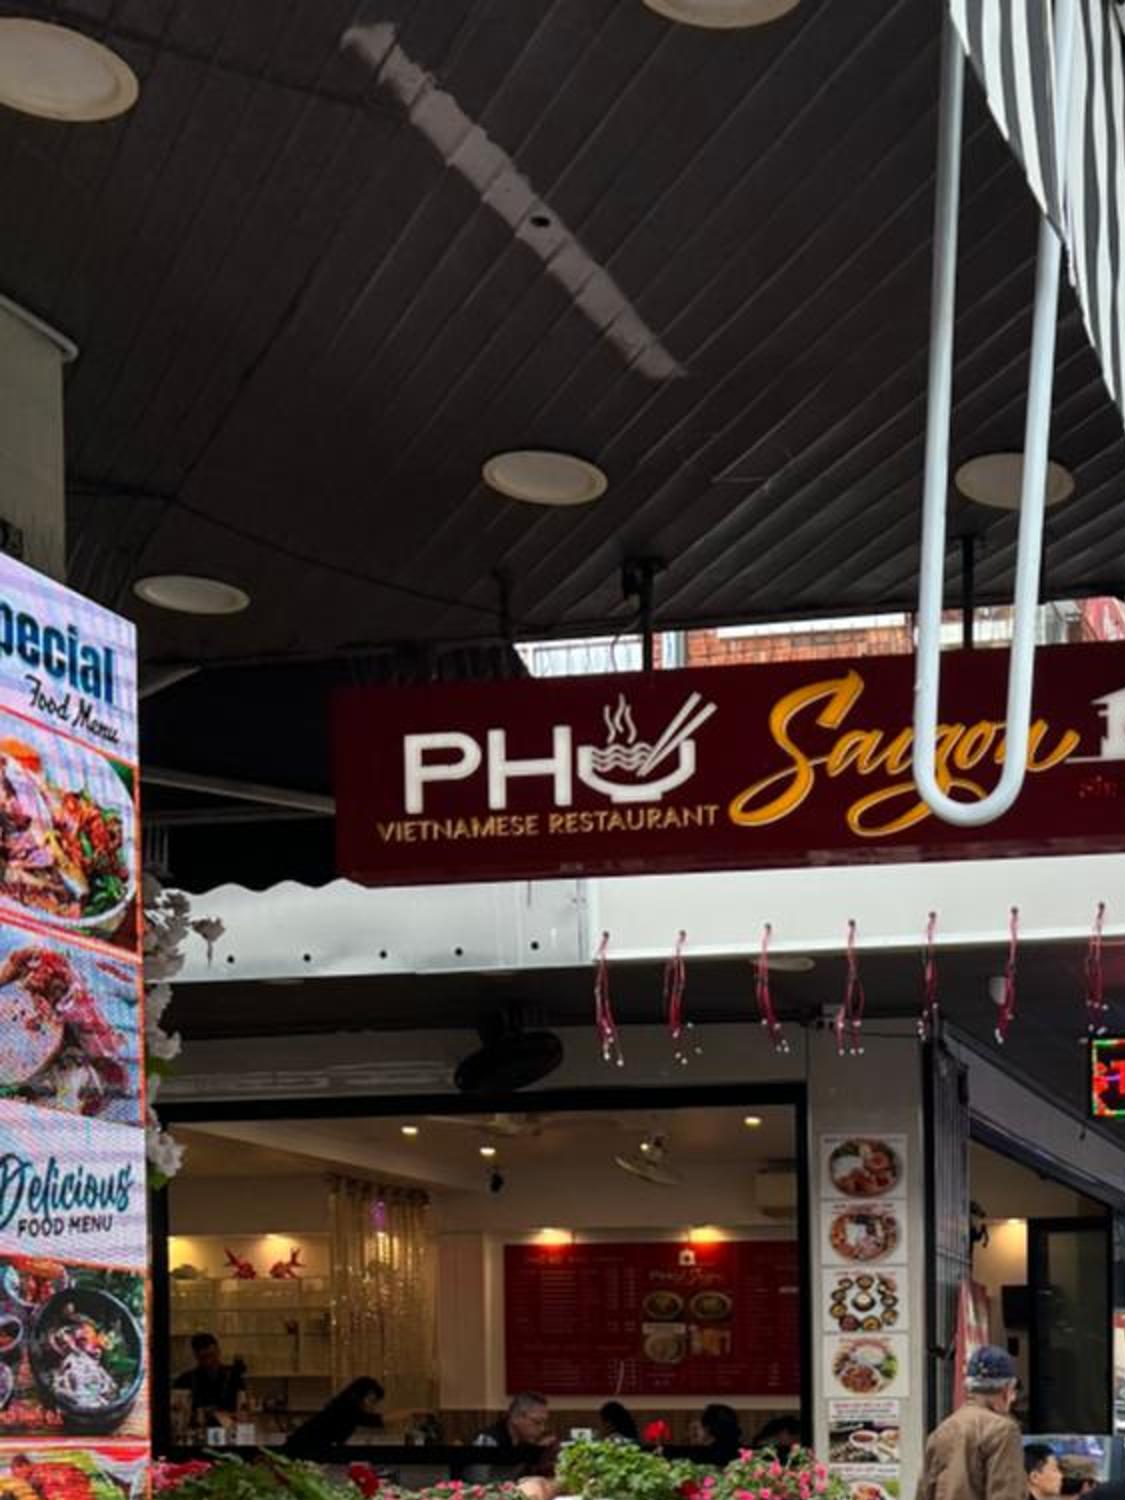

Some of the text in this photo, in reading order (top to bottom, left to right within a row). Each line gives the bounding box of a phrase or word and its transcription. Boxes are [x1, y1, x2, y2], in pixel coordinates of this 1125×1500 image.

[25, 674, 119, 745] Food Menu
[376, 804, 720, 843] VIETNAMESE RESTAURANT
[18, 1214, 114, 1238] FOOD MENU
